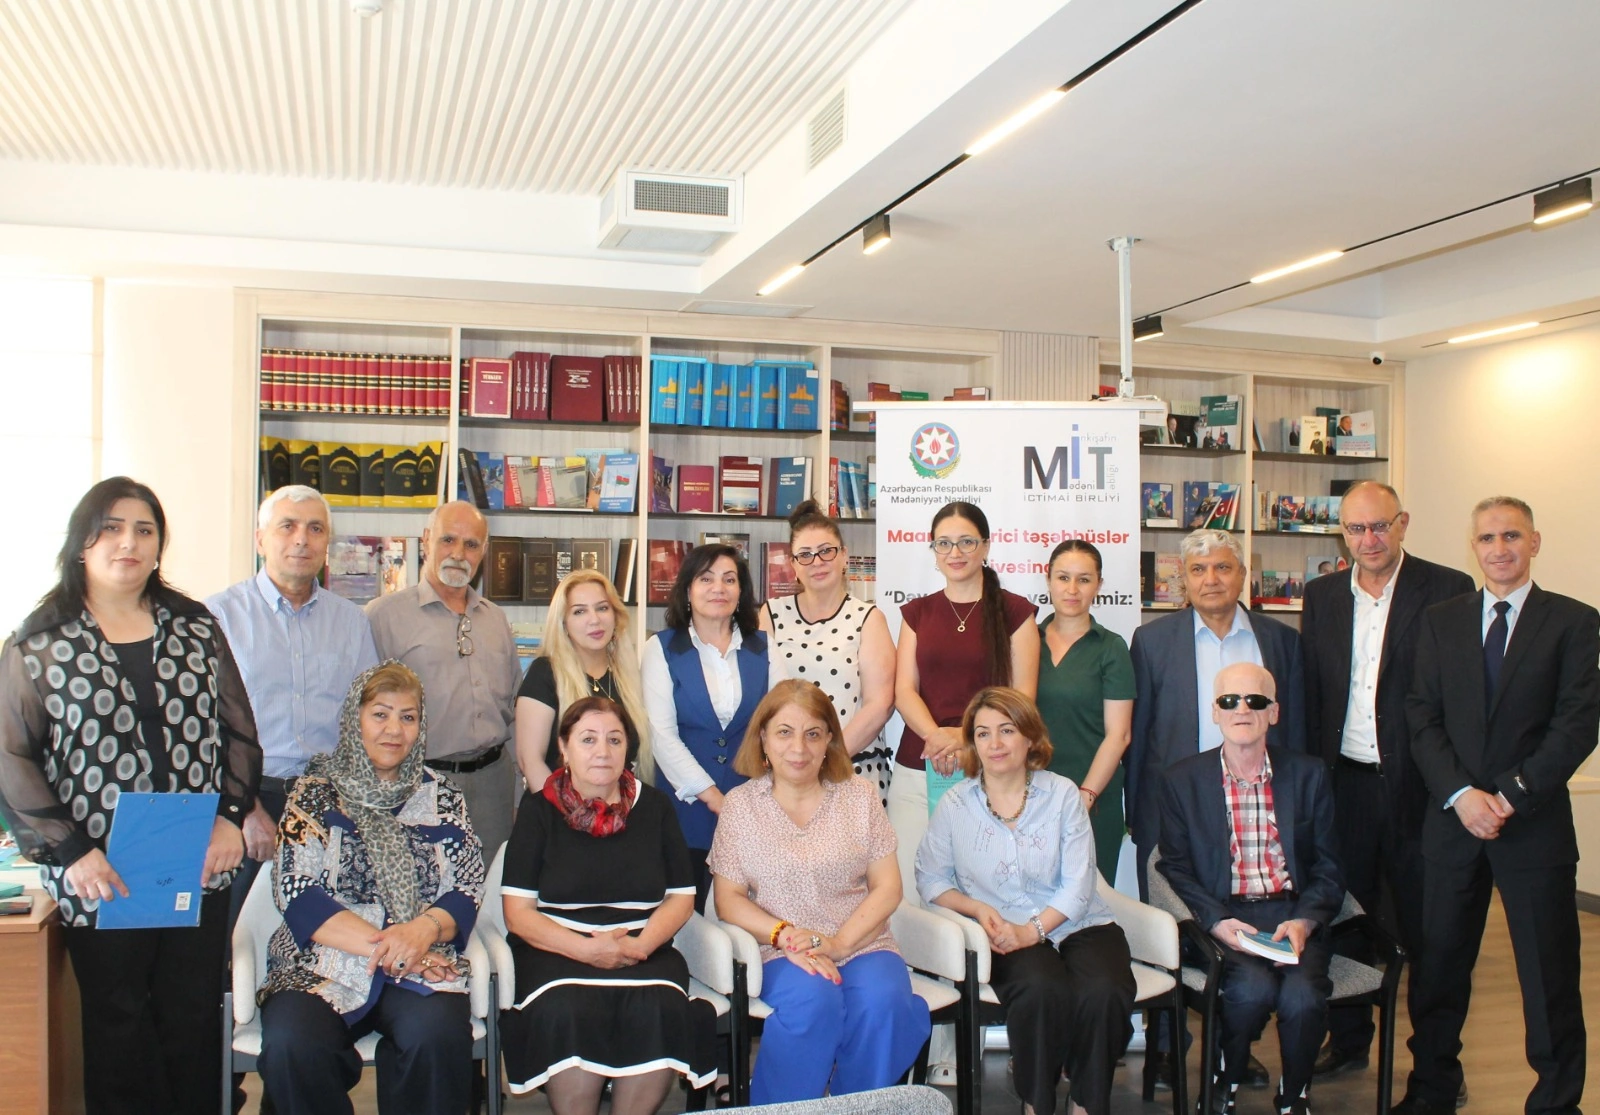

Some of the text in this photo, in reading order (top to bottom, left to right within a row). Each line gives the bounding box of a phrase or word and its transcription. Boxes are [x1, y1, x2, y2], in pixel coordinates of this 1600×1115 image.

[880, 485, 992, 496] Azərbaycan Respublikası
[891, 495, 942, 505] Mədəniyyət
